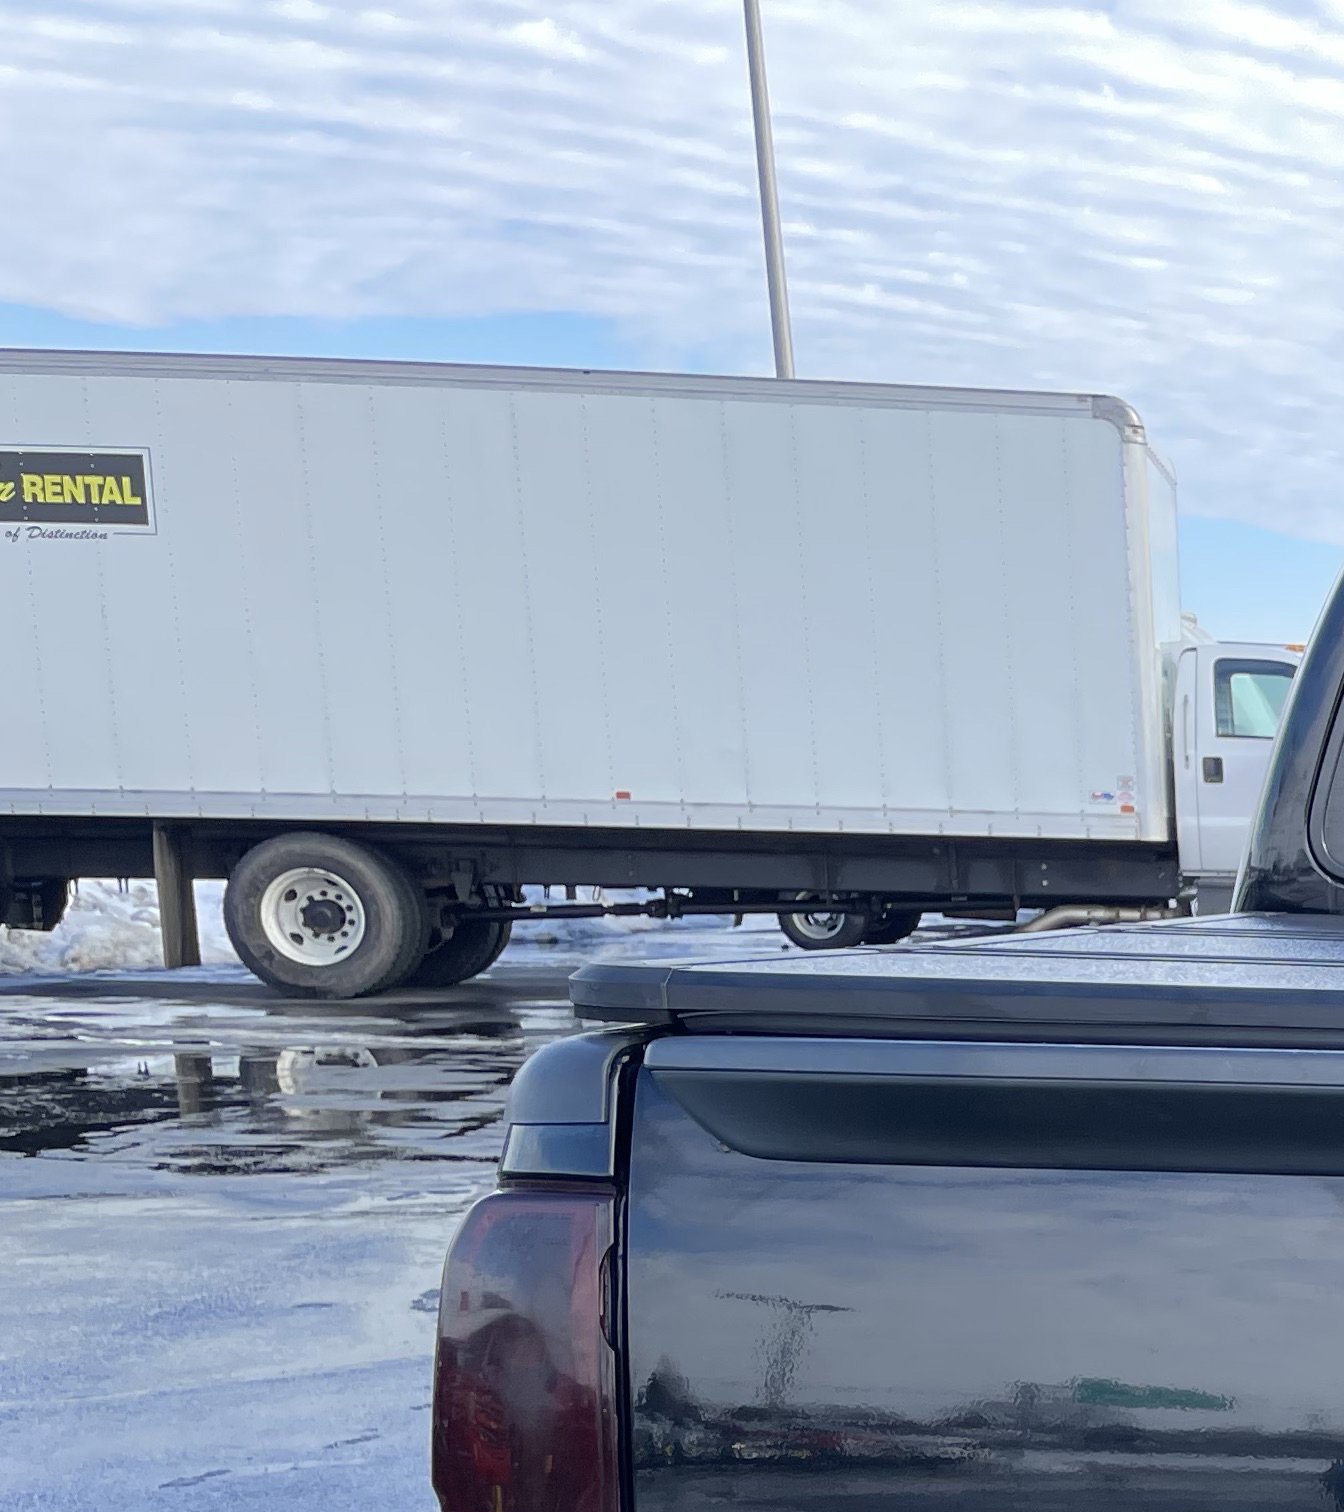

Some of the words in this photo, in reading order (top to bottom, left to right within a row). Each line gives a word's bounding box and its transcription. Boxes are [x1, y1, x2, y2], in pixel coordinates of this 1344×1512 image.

[22, 473, 142, 505] RENTAL
[5, 527, 20, 542] of
[25, 526, 108, 540] Distinction
